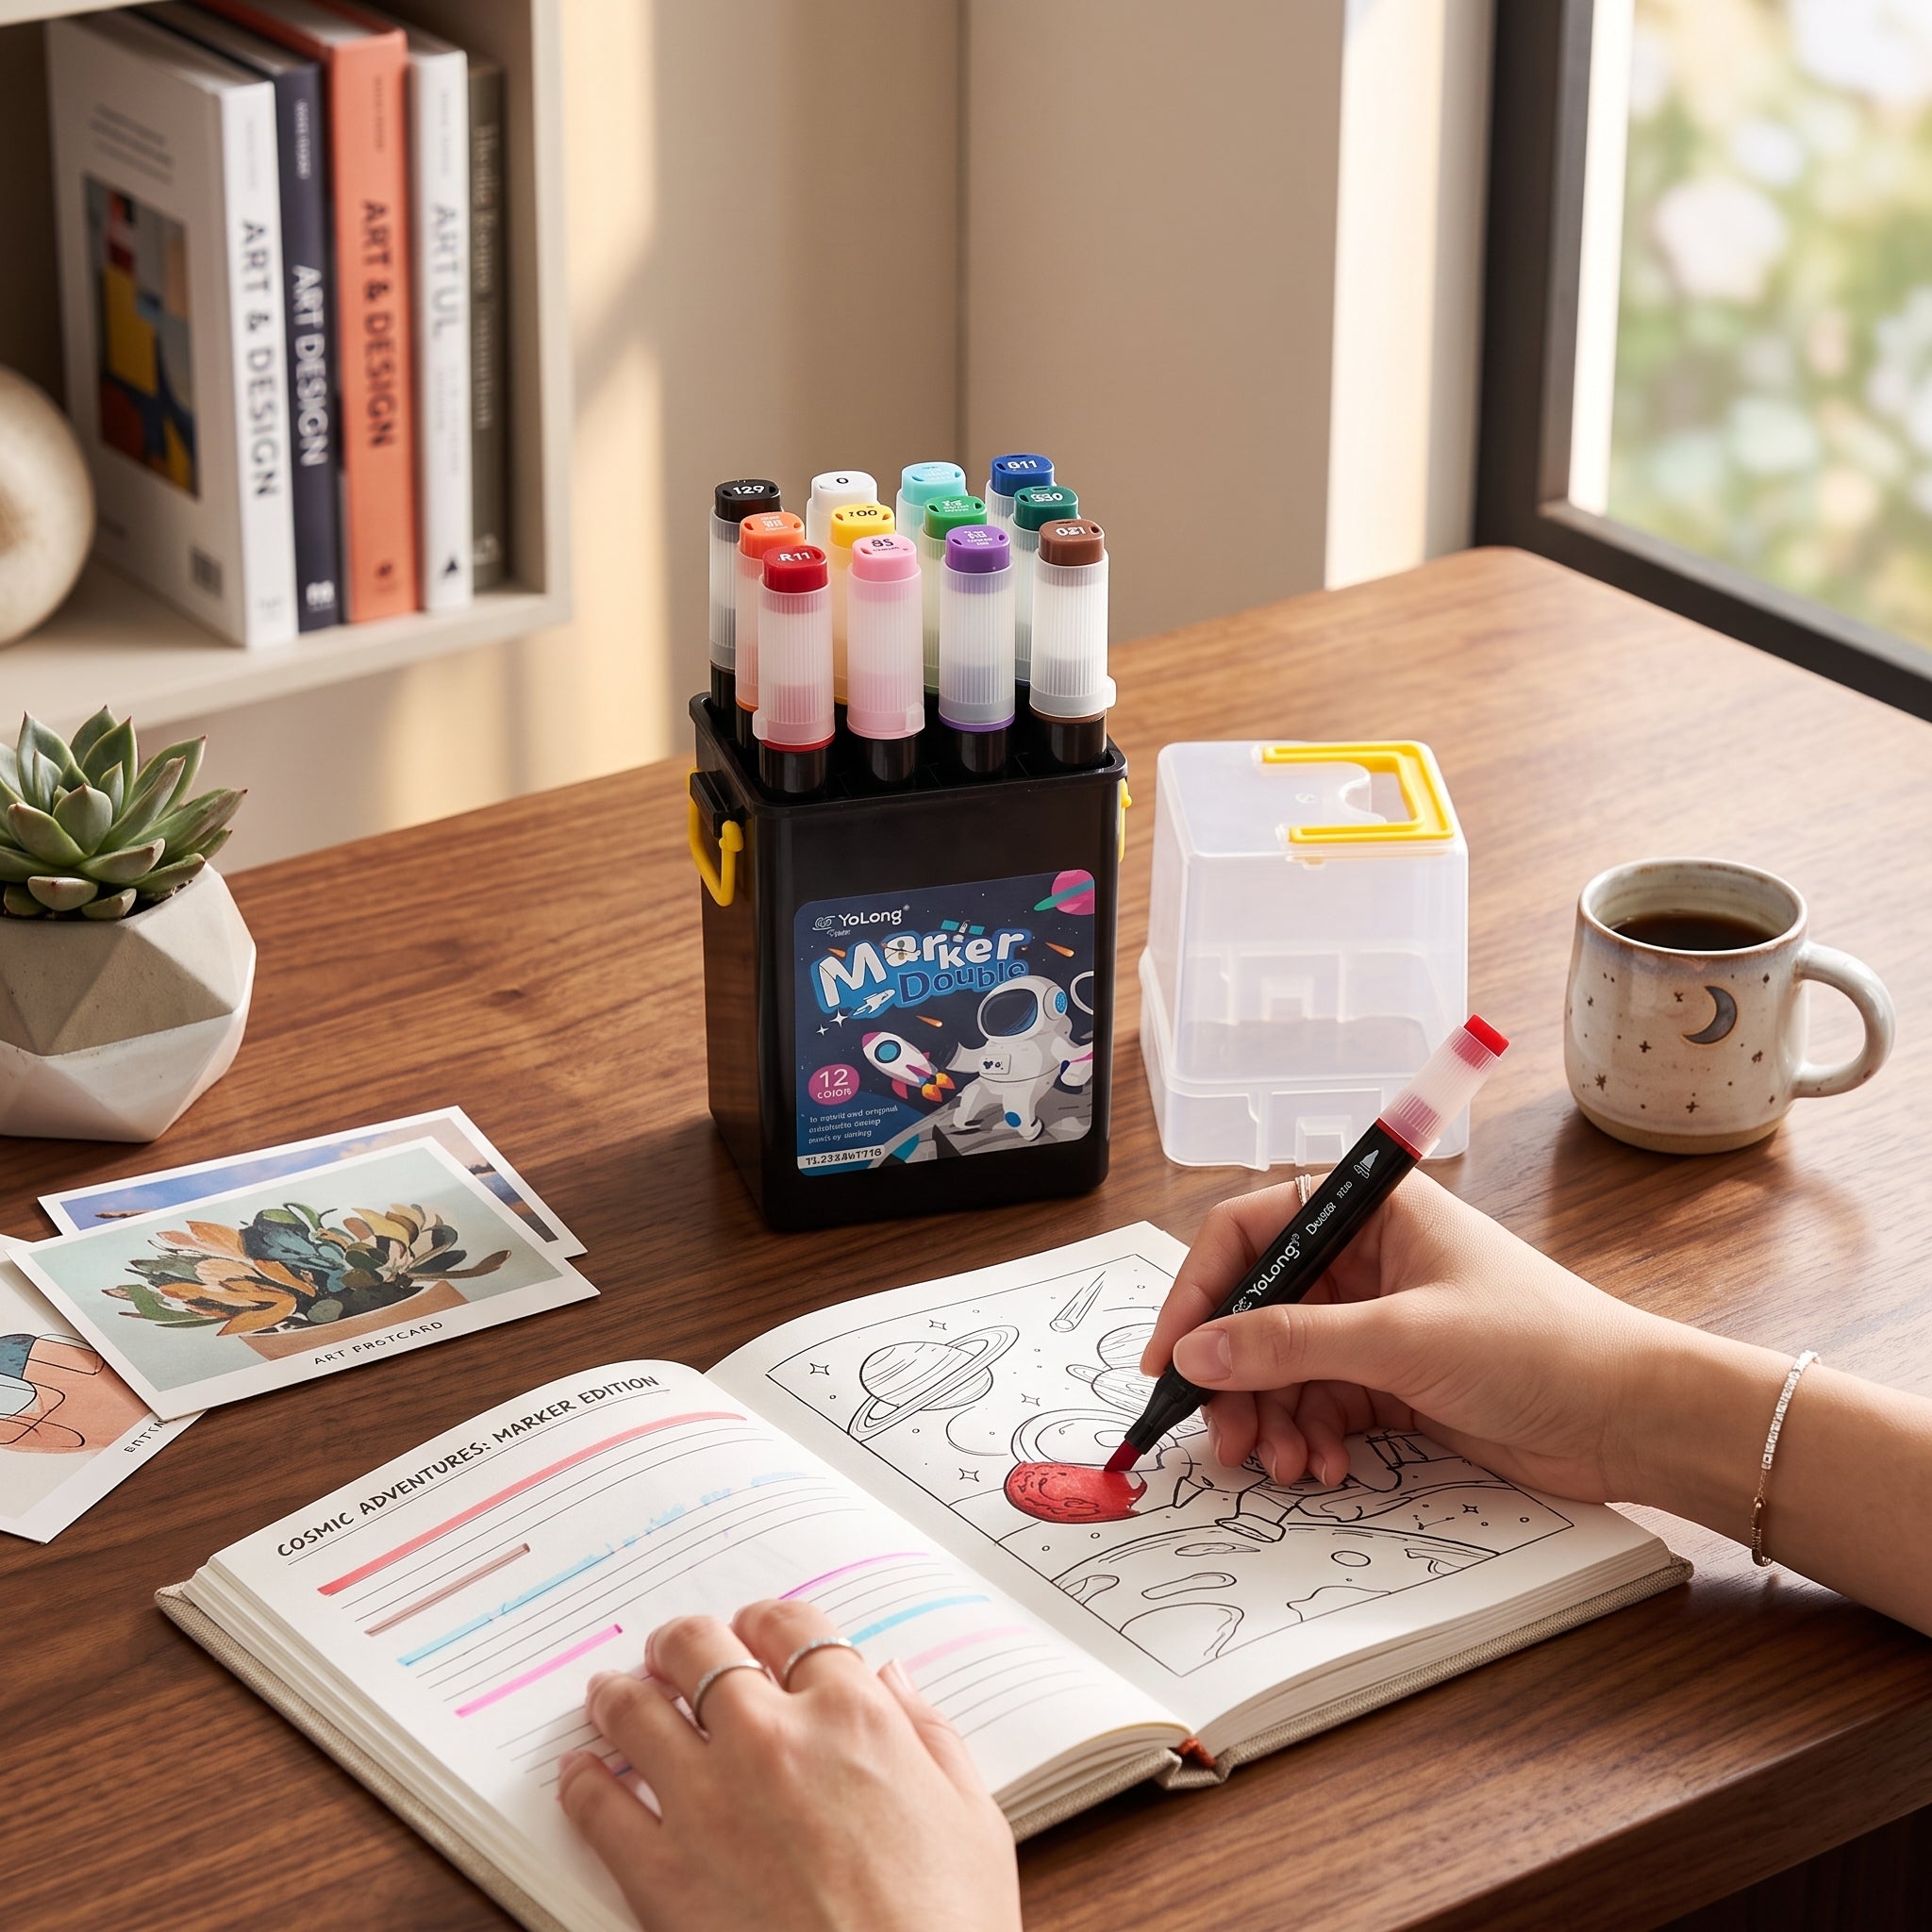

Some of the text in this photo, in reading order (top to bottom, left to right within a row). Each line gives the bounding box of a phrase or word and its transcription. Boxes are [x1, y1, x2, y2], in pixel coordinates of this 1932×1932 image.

[242, 219, 269, 292] ART
[245, 310, 271, 333] &
[292, 264, 328, 467] ART DESIGN
[364, 311, 395, 449] DESIGN
[246, 345, 280, 500] DESIGN
[733, 485, 765, 495] 129
[838, 909, 903, 927] YoLong
[819, 933, 1025, 1008] Marker
[898, 960, 1027, 1004] Double
[819, 1068, 849, 1088] 12
[1245, 1241, 1301, 1296] YoLong
[314, 1349, 346, 1365] ART
[276, 1375, 659, 1557] COSMIC ADVENTURES: MARKER EDITION
